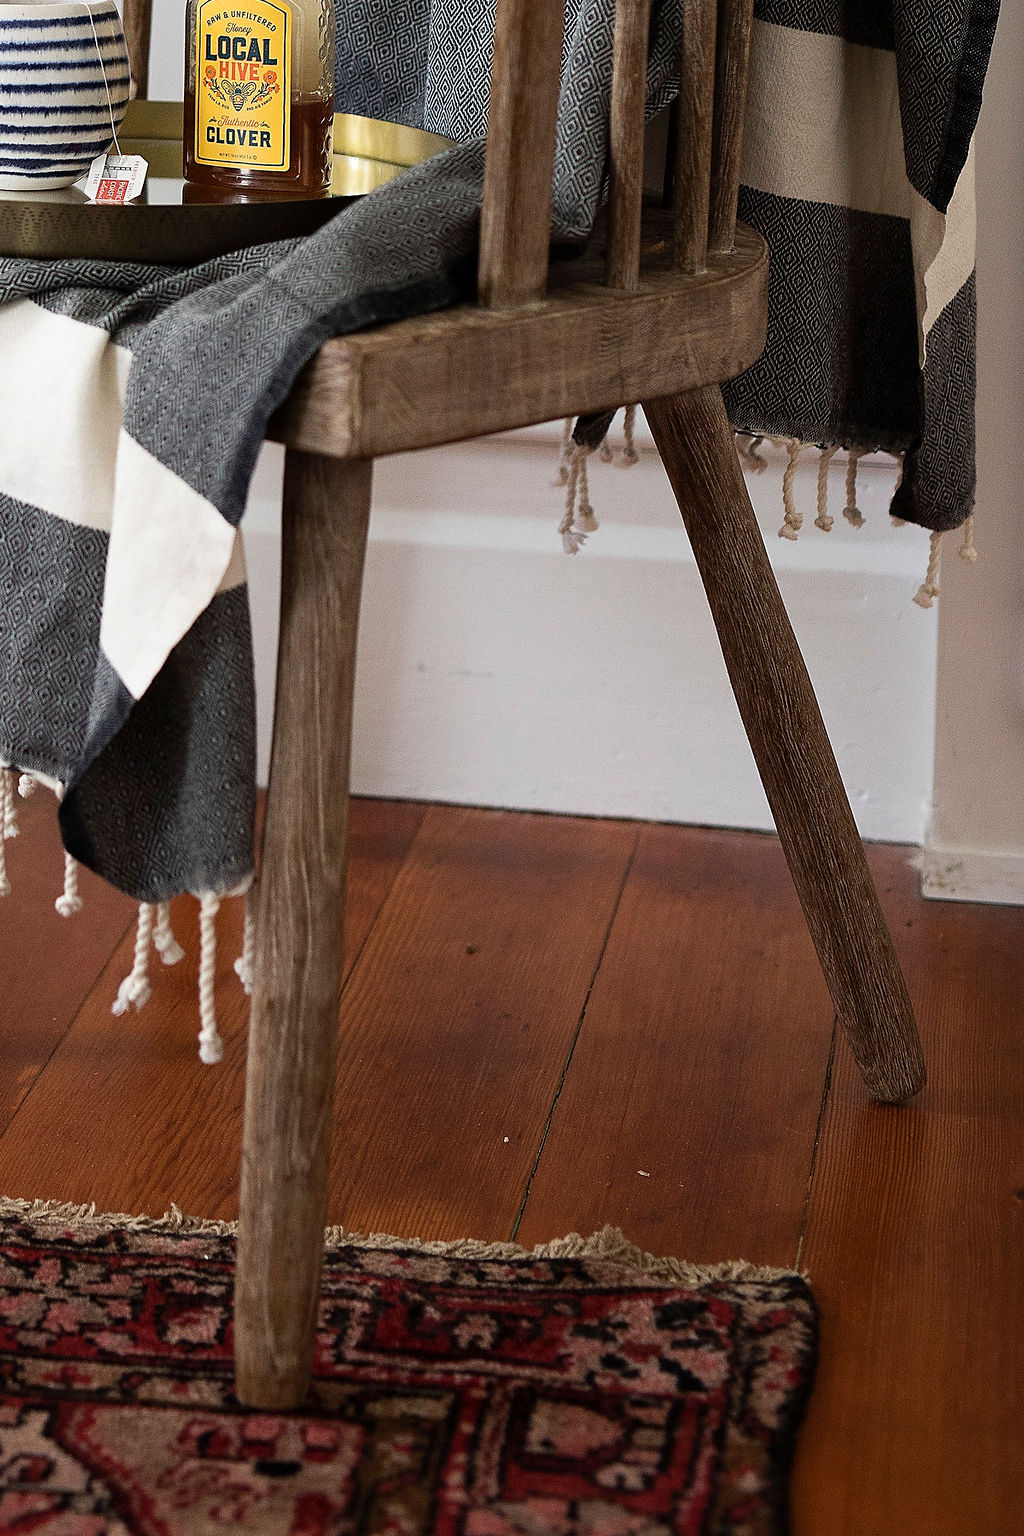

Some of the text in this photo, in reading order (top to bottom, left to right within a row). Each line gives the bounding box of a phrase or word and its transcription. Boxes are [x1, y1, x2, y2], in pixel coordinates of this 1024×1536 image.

[206, 10, 277, 32] RAW & UNFILTERED
[225, 22, 253, 36] Honey
[205, 34, 278, 66] LOCAL
[219, 61, 260, 81] HIVE
[217, 114, 260, 127] Authentic
[206, 126, 272, 148] CLOVER
[107, 181, 117, 197] COAST
